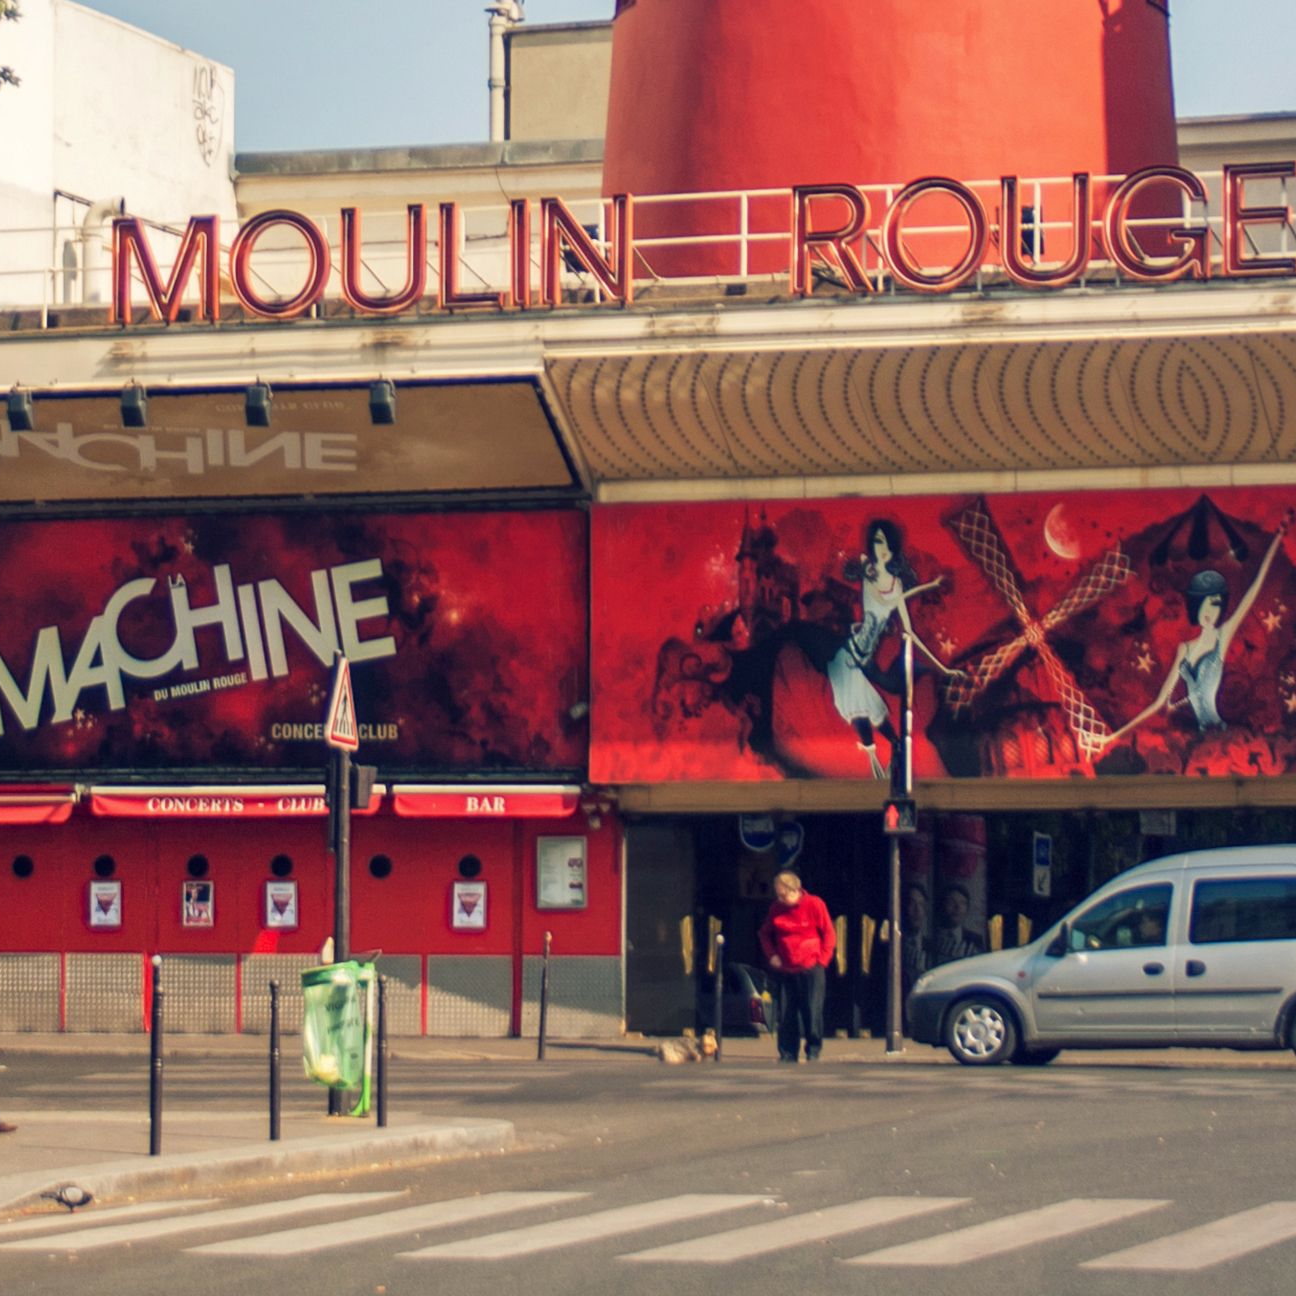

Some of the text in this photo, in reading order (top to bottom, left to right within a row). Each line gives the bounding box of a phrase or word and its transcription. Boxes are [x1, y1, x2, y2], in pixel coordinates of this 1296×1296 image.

[110, 192, 635, 325] MOULIN
[154, 671, 248, 701] DU MOULIN ROUGE
[271, 722, 398, 740] CONCE CLUB
[147, 795, 245, 813] CONCERTS
[466, 796, 506, 813] BAR
